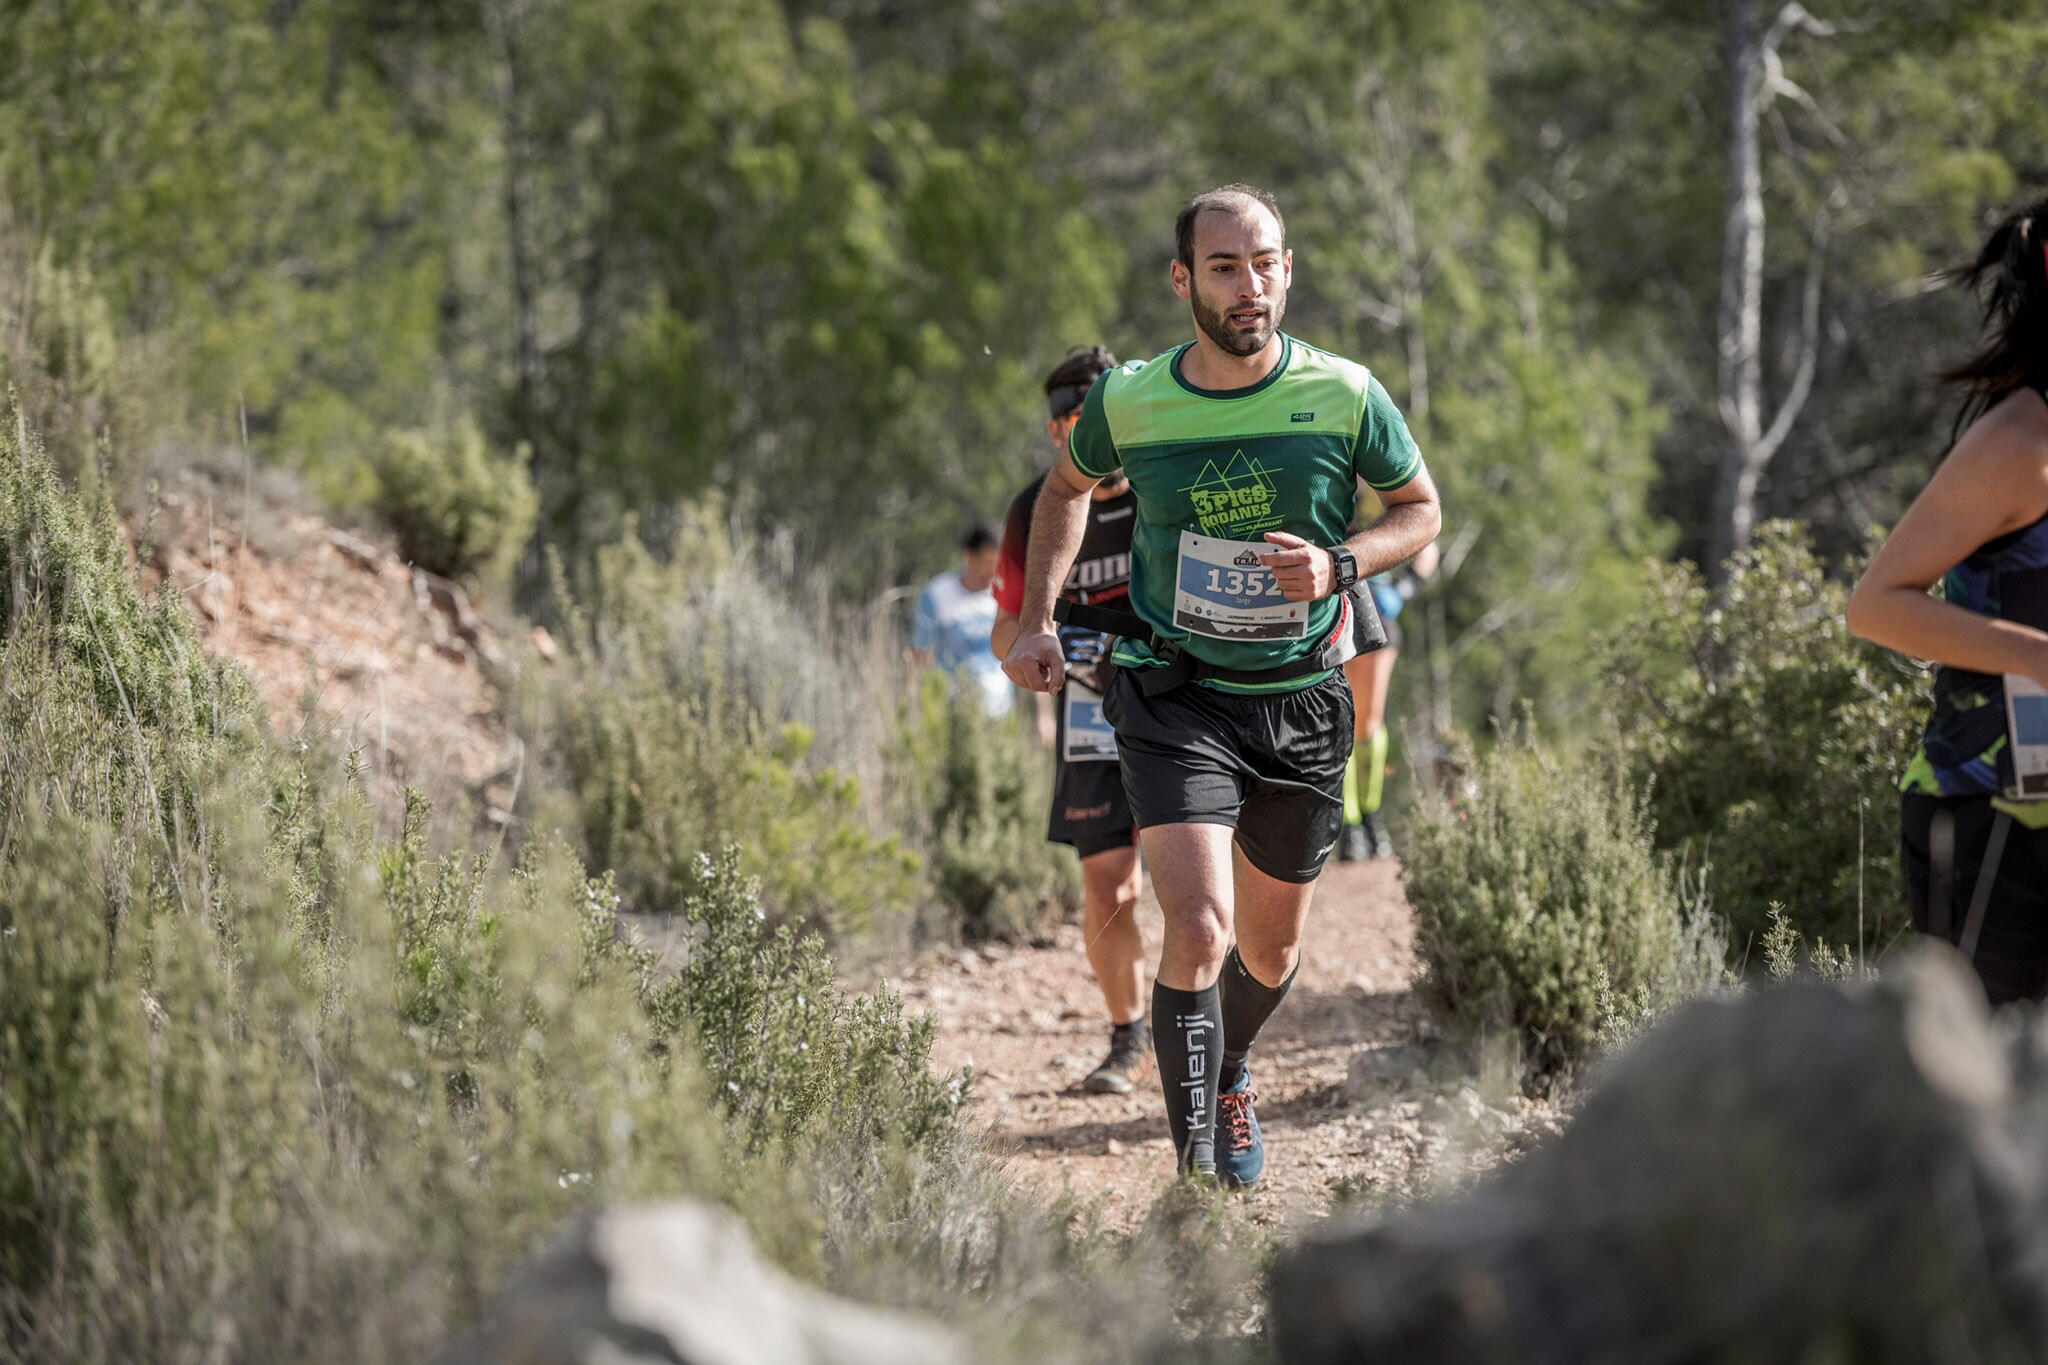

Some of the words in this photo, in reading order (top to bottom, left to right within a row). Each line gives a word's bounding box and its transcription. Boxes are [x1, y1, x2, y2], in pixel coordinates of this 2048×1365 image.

[1198, 503, 1272, 533] RODANES
[1206, 568, 1283, 597] 1352
[1235, 597, 1252, 606] Jorge
